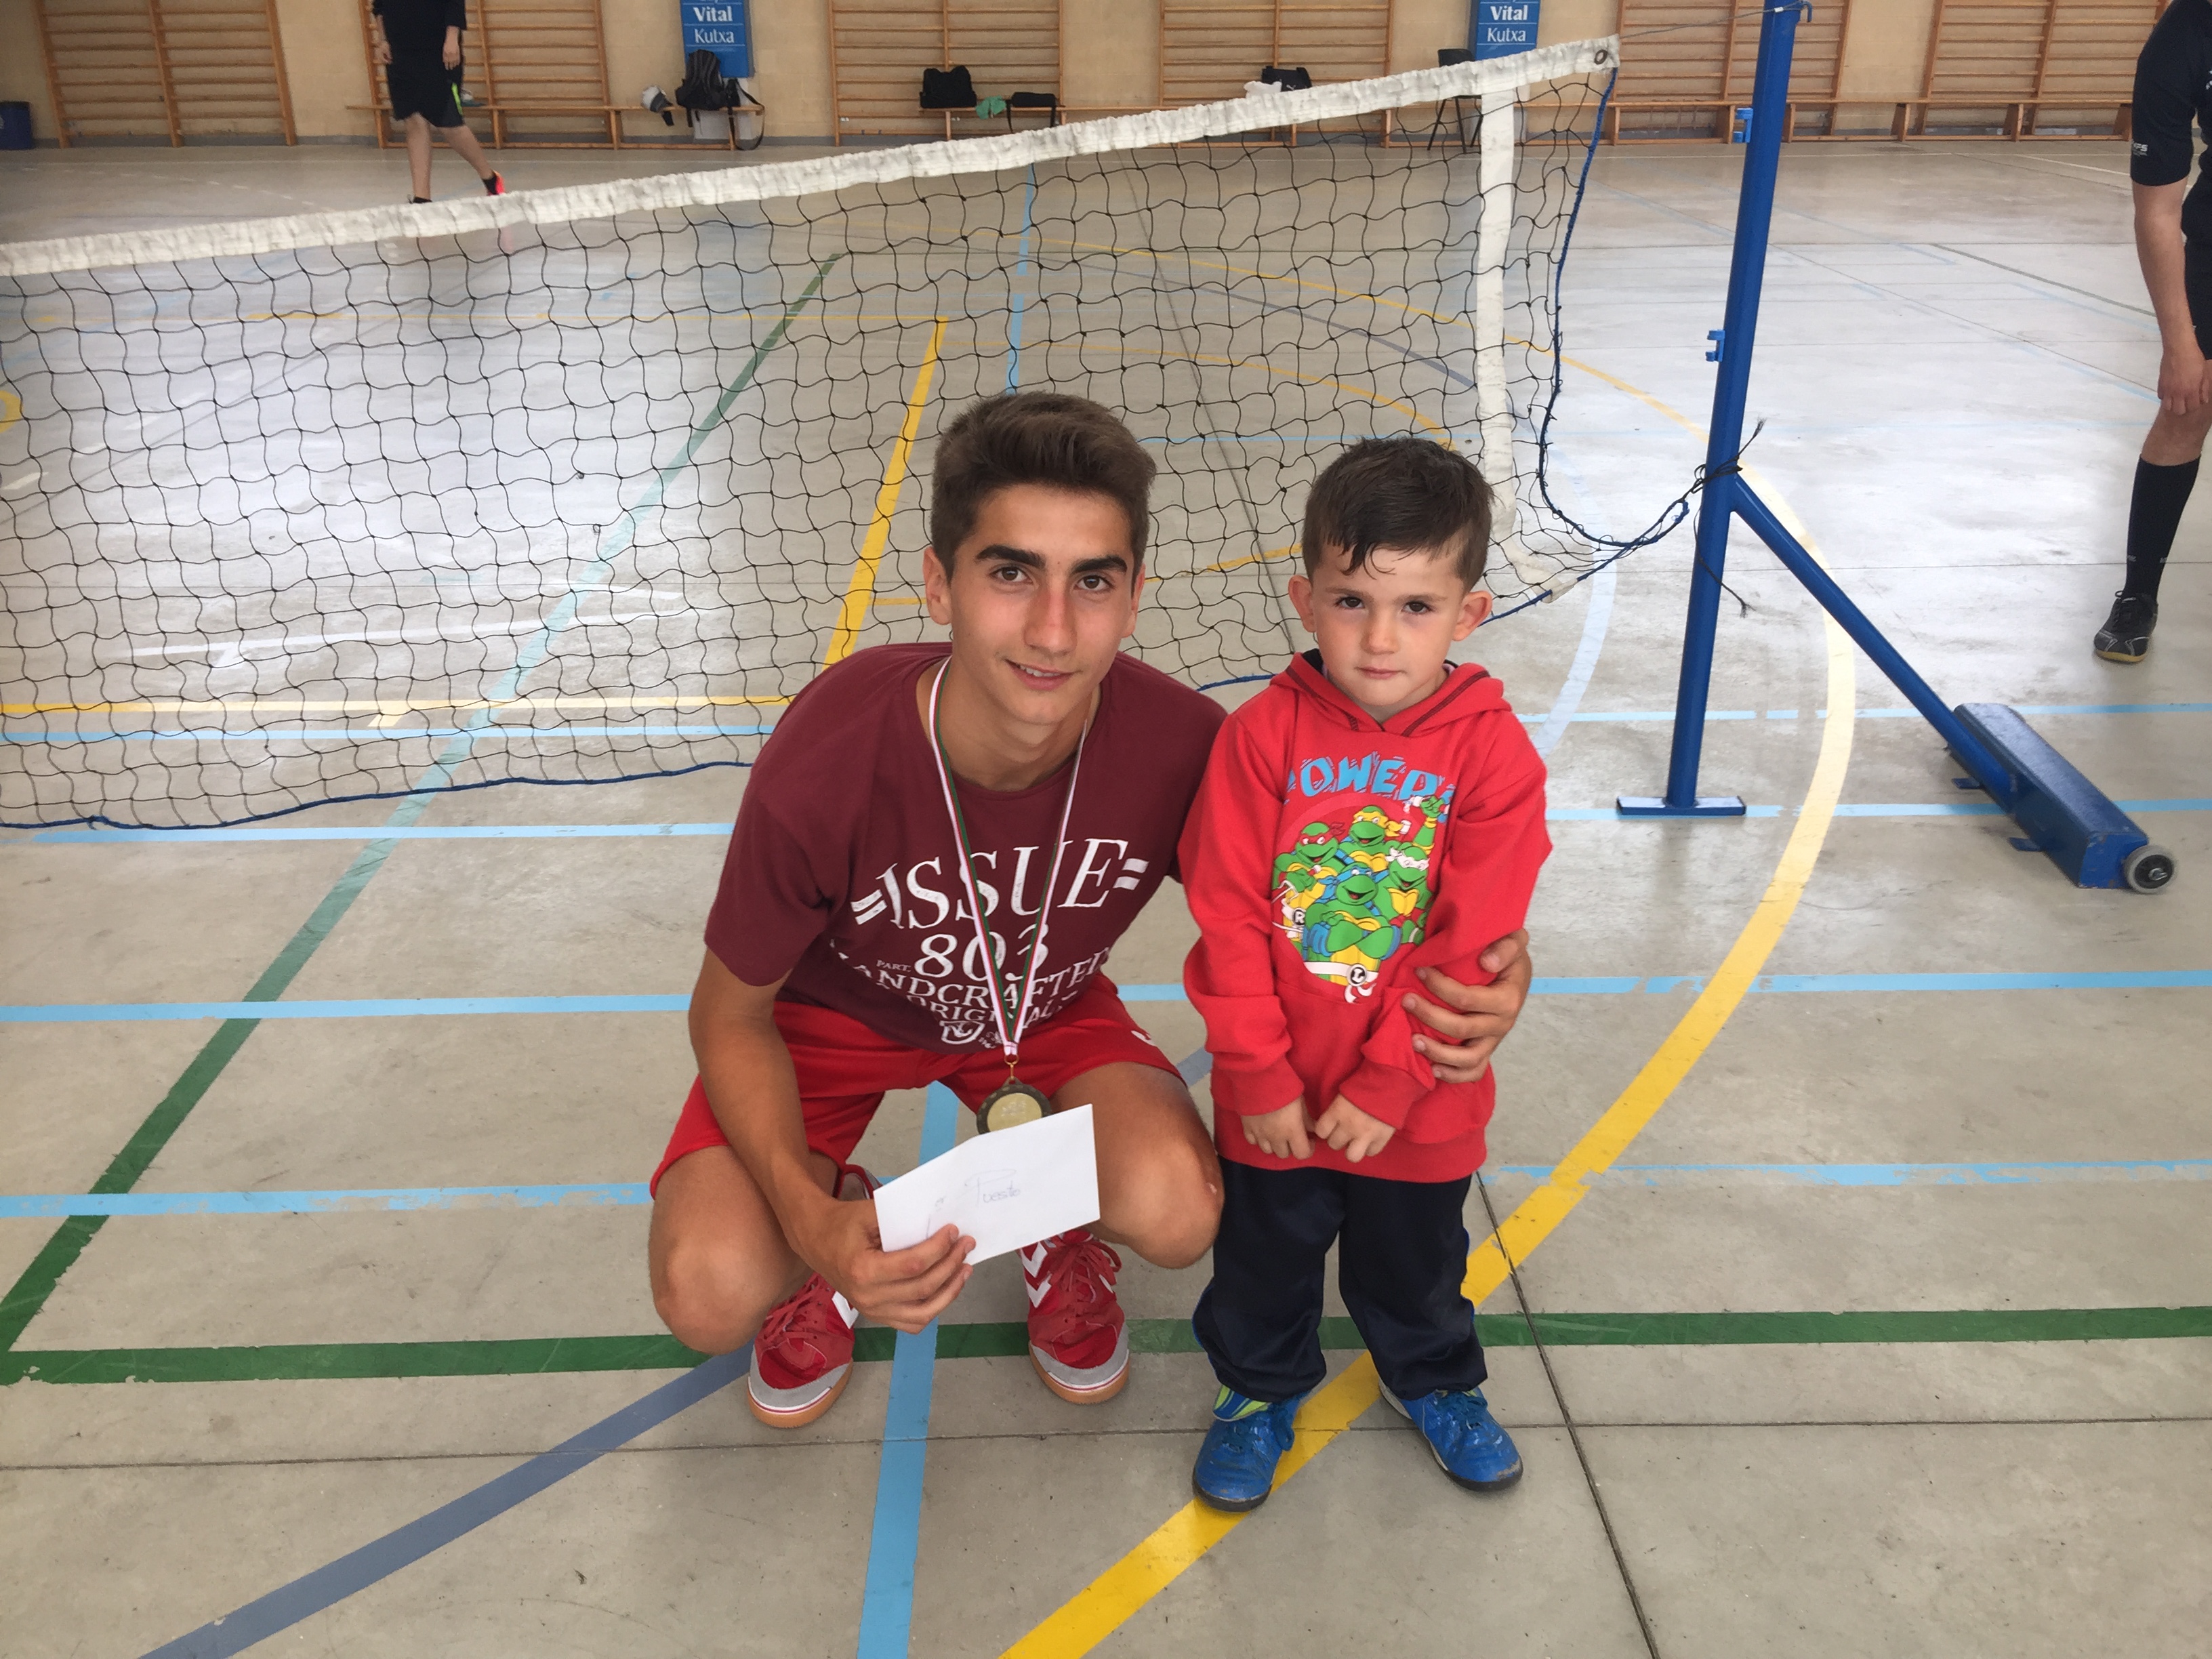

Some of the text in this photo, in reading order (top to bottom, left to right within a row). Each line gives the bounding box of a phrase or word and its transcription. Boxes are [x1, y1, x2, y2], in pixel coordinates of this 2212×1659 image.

[693, 5, 733, 22] Vital
[1490, 5, 1528, 21] Vital
[694, 28, 735, 44] Kutxa
[1487, 27, 1526, 42] Kutxa
[1287, 752, 1455, 819] OWER
